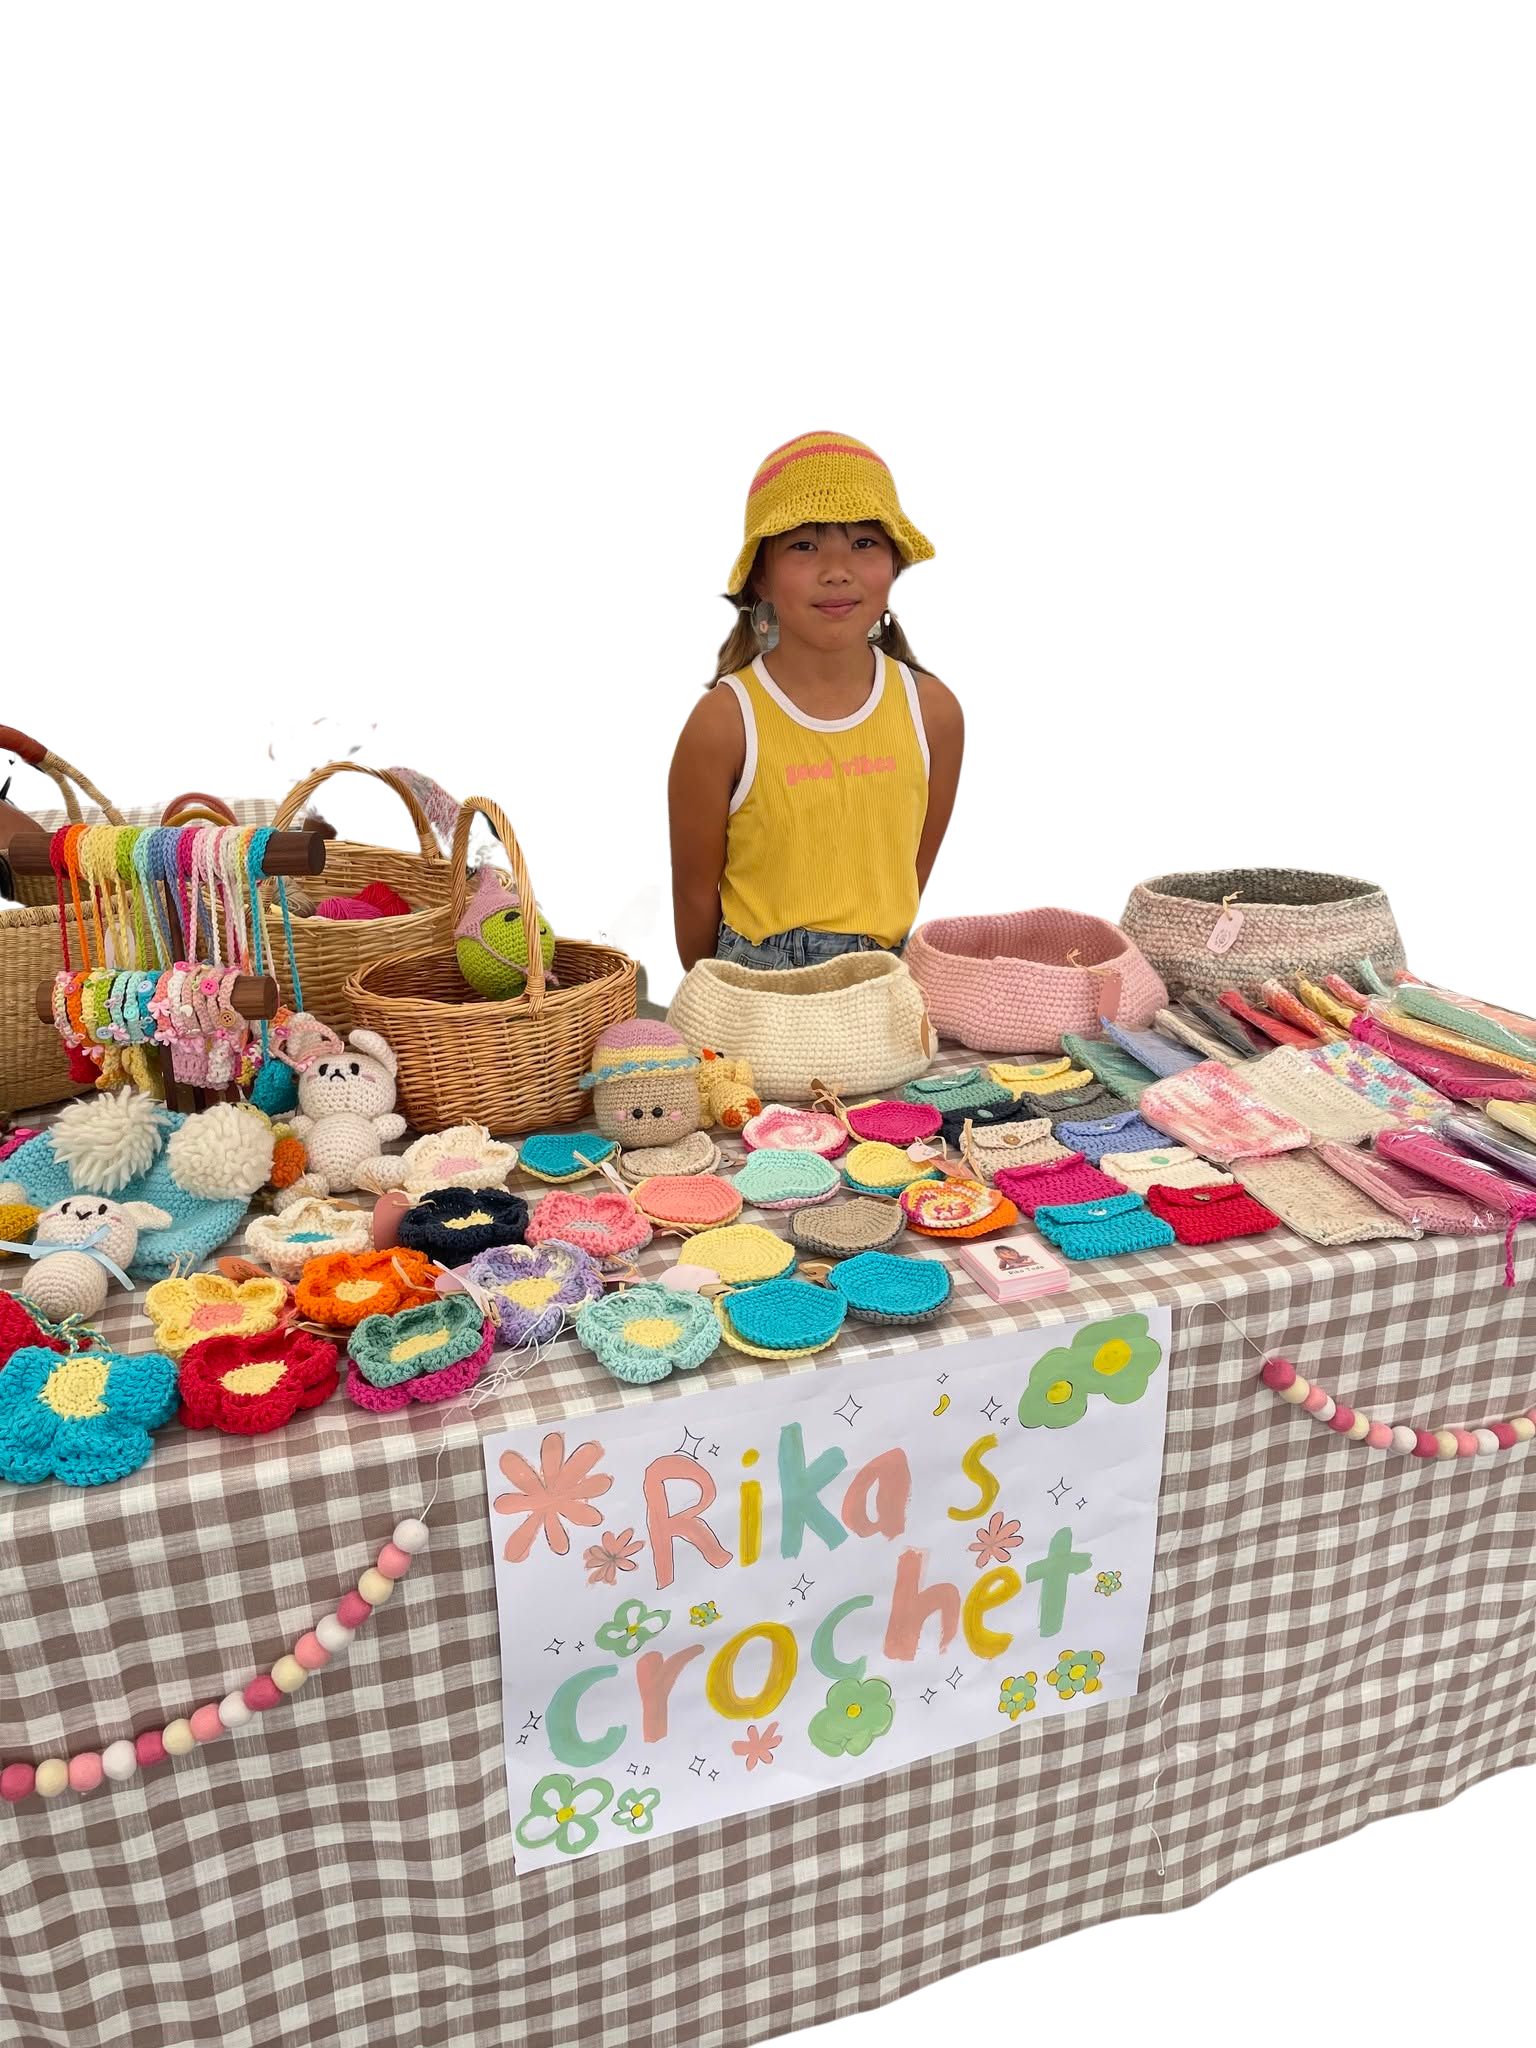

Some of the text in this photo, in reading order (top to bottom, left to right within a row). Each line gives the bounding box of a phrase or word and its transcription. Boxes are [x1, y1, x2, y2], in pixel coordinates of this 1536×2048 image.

[786, 755, 896, 786] good vibes
[545, 1526, 1093, 1767] crochet
